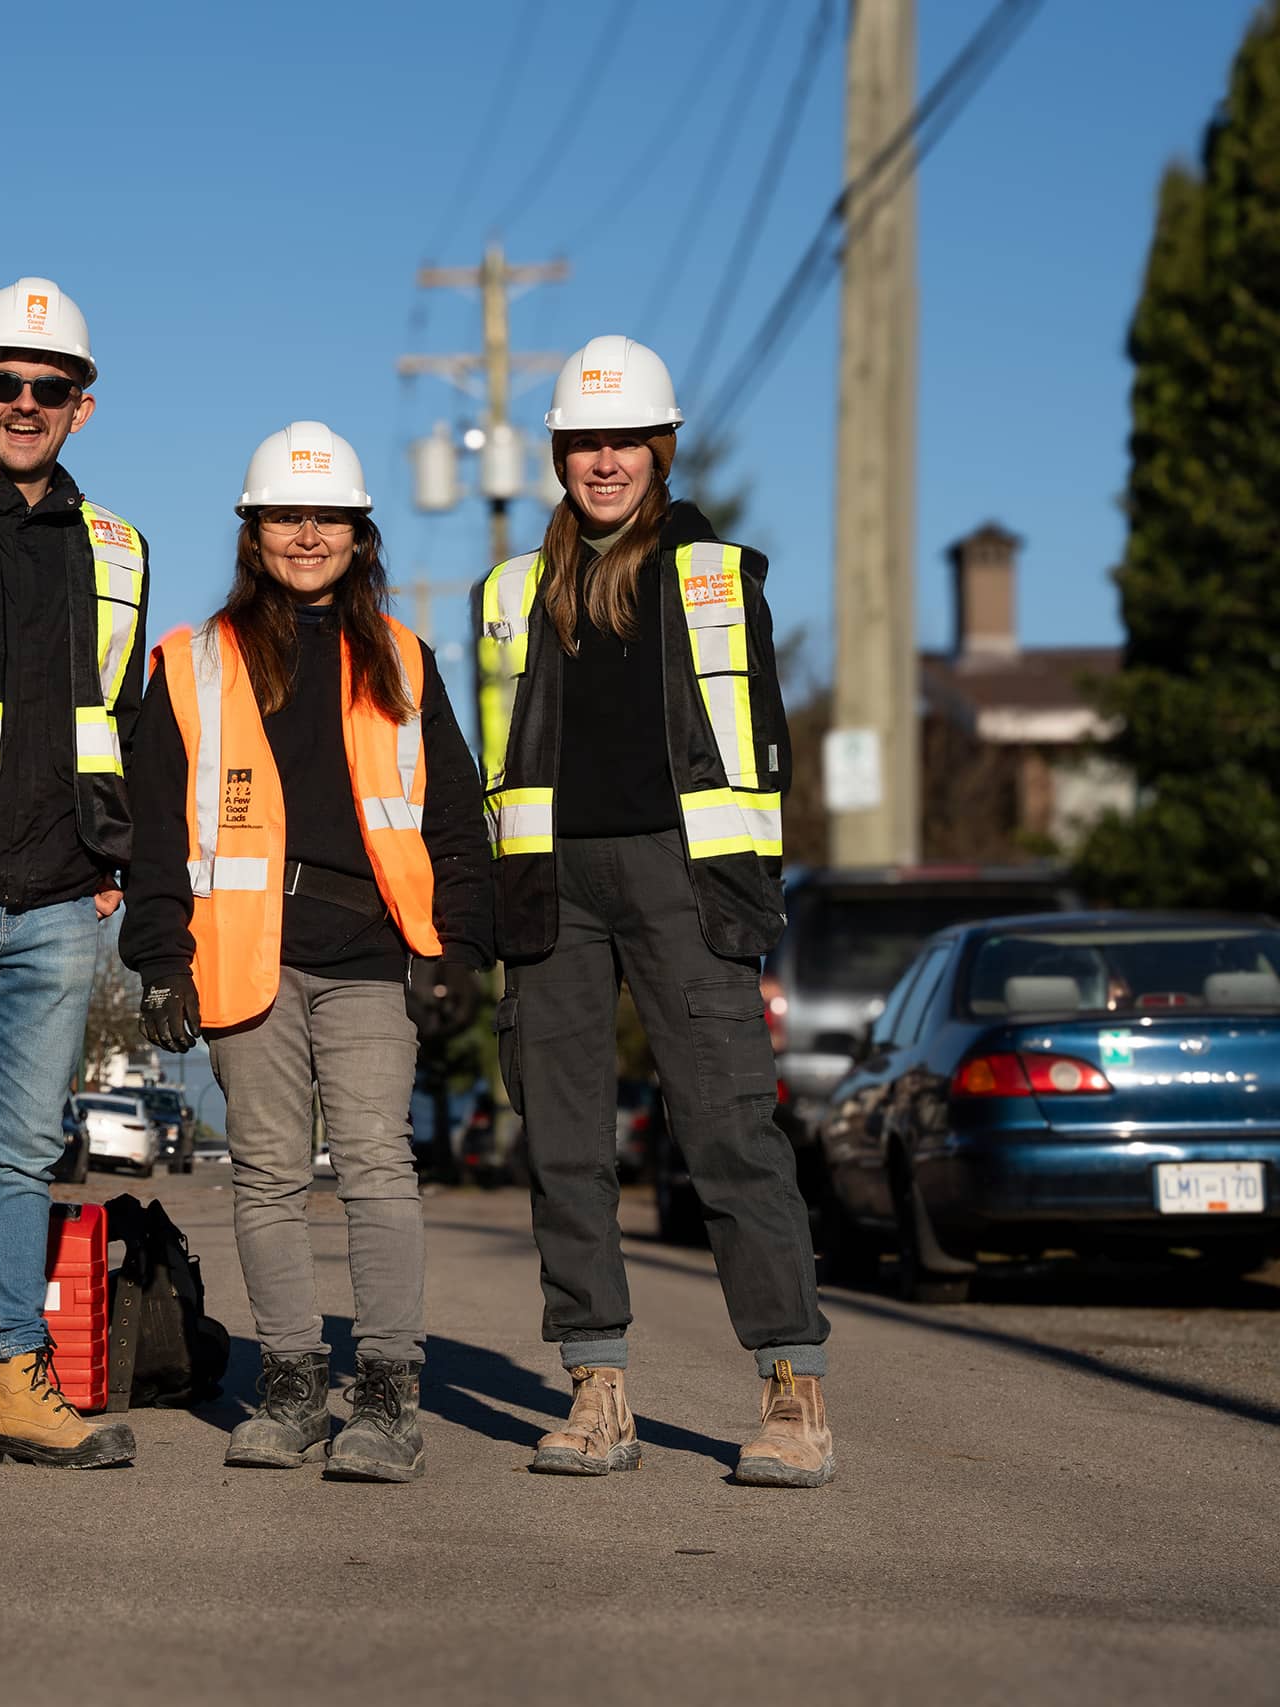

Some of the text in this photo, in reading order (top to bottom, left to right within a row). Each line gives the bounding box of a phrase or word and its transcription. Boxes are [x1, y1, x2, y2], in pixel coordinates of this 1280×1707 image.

[714, 589, 733, 597] Lads
[225, 796, 231, 804] A
[226, 805, 248, 813] Good
[226, 814, 246, 822] Lads
